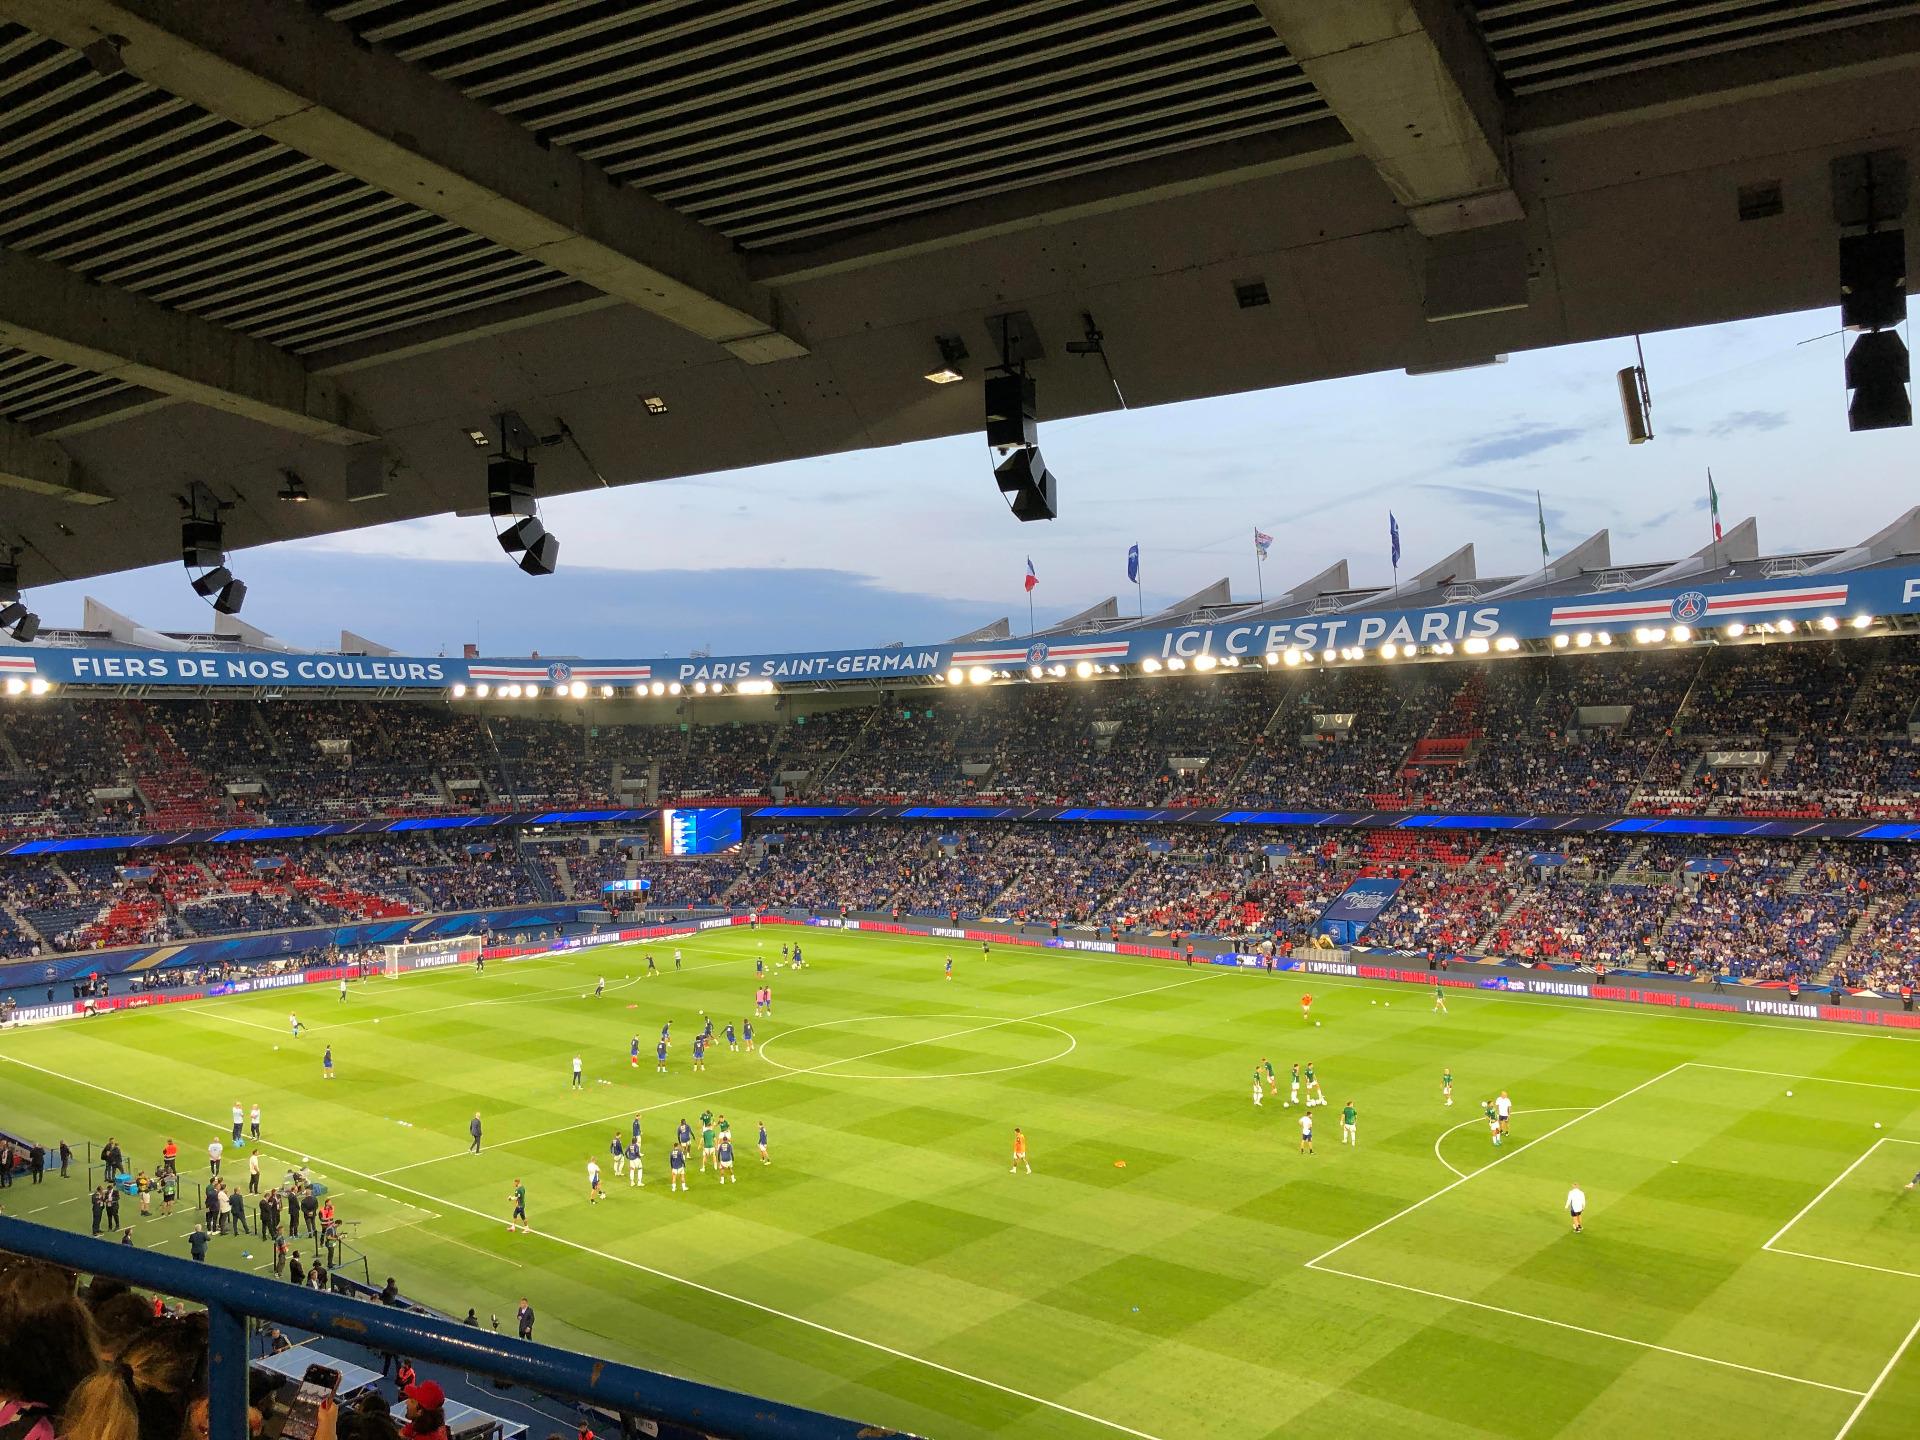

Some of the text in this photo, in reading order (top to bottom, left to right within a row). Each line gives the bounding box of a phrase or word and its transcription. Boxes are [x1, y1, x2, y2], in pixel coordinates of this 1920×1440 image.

[1161, 607, 1500, 658] ICI C'EST PARIS
[72, 657, 444, 681] FIERS DE NOS COULEURS
[679, 651, 940, 680] PARIS SAINT-GERMAIN
[1308, 961, 1357, 976] L'APPLICATION
[1528, 981, 1588, 997] L'APPLICATION
[11, 1003, 73, 1021] L'APPLICATION
[1746, 1000, 1818, 1018] L'APPLICATION
